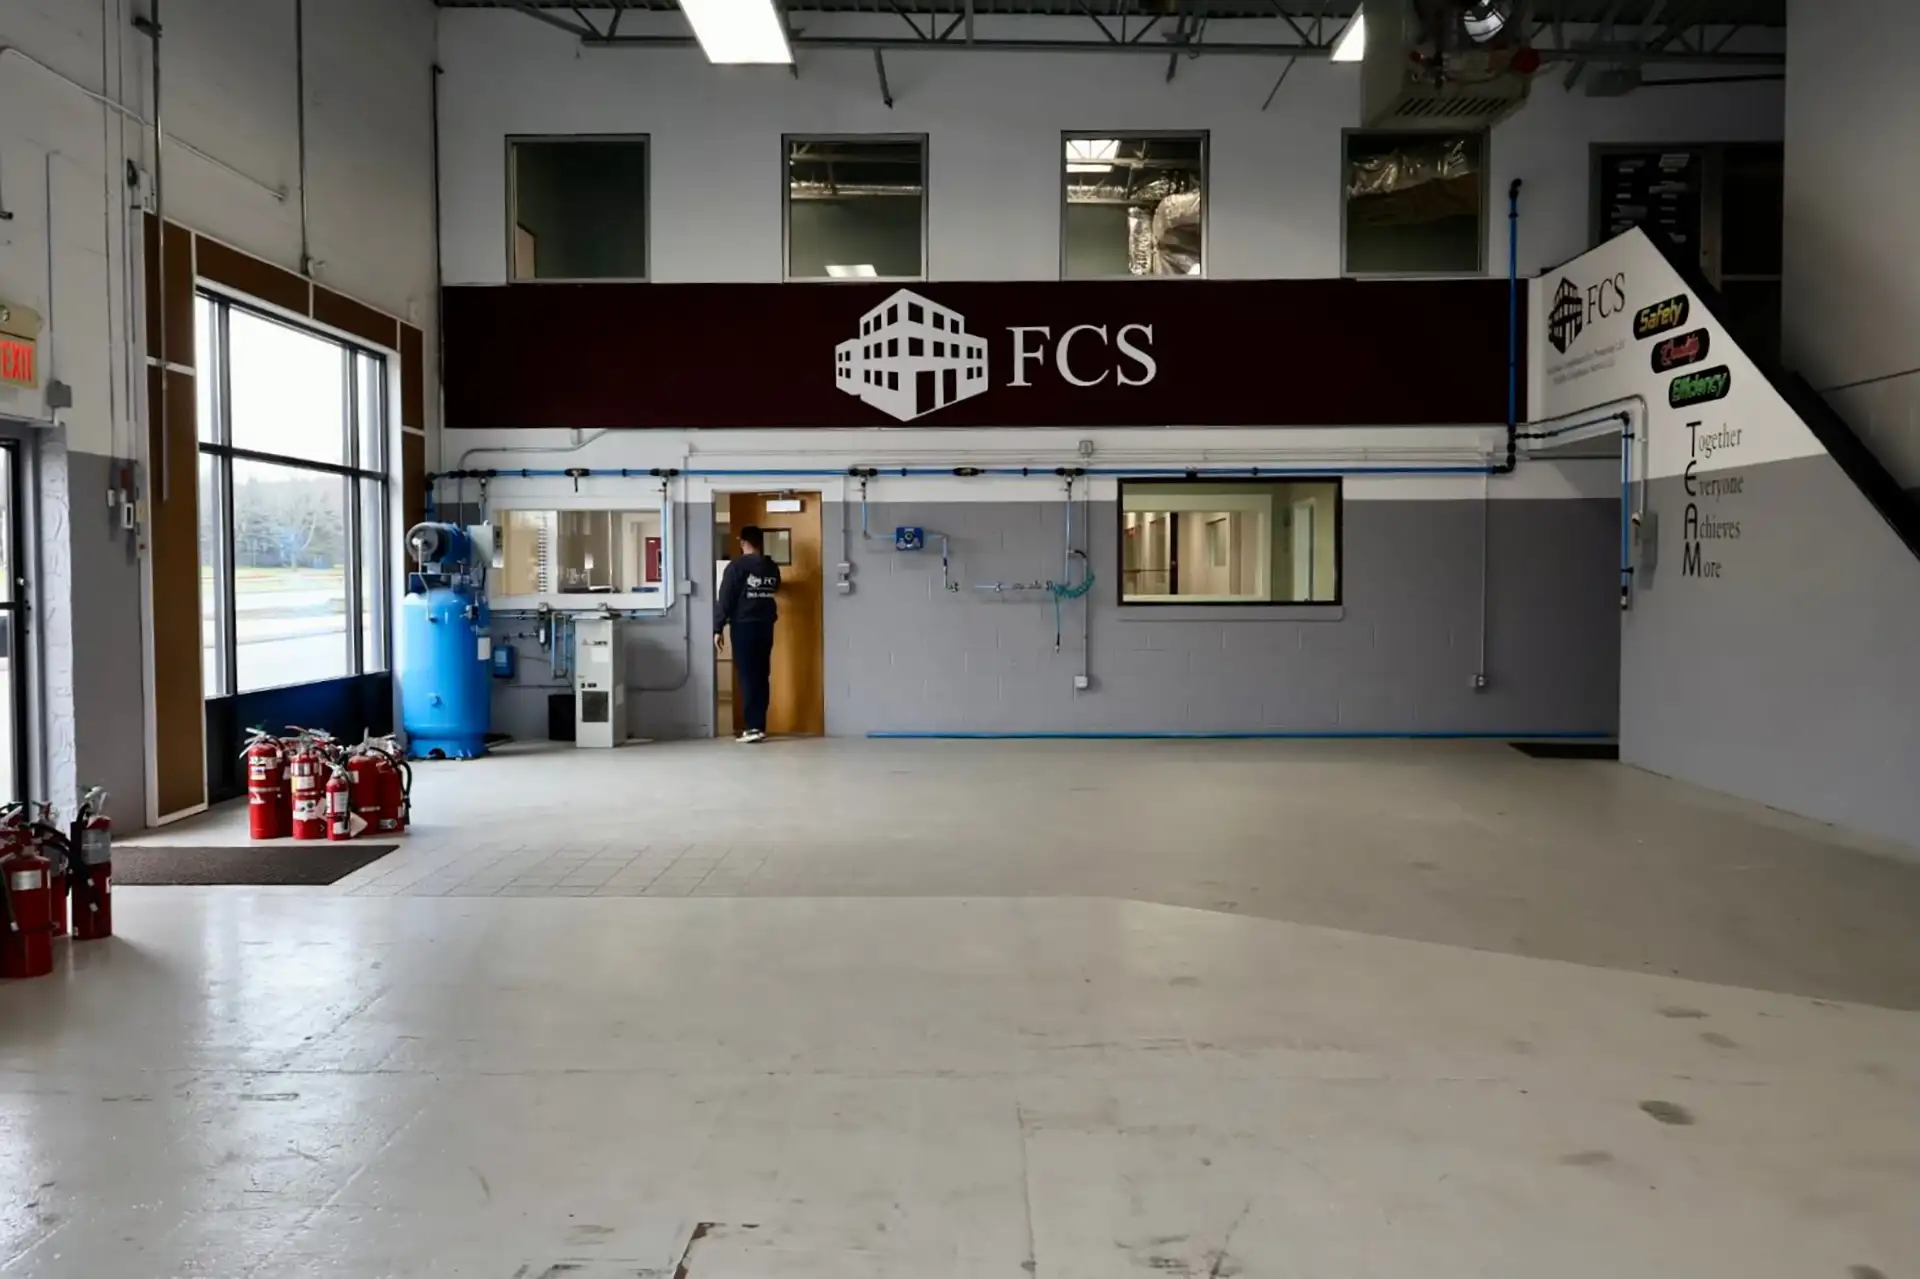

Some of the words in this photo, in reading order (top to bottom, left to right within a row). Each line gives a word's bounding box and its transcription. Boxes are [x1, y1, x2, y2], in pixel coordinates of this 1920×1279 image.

[1586, 272, 1626, 325] FCS
[1638, 299, 1684, 333] Safety
[1, 341, 34, 384] EXIT
[1005, 323, 1158, 387] FCS
[1686, 421, 1743, 459] Together
[1684, 459, 1744, 502] Everyone
[1683, 502, 1742, 540] Achieves
[1682, 541, 1723, 579] More
